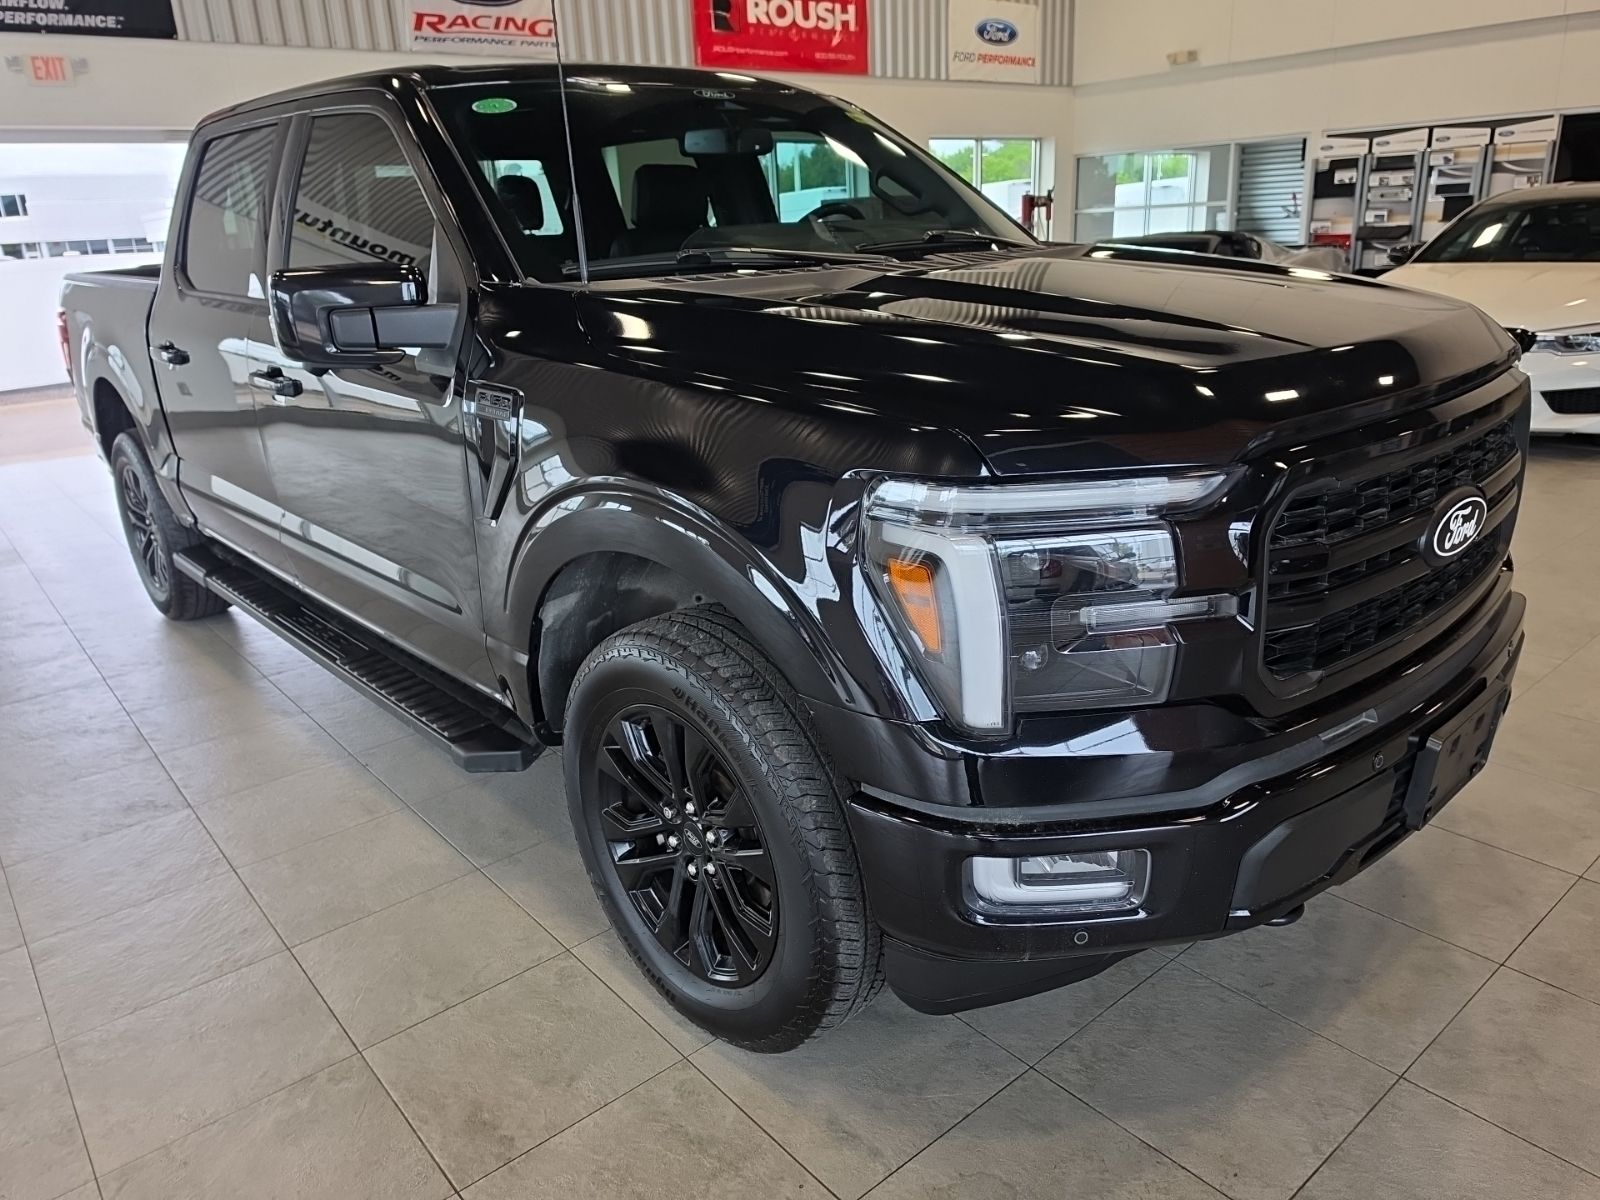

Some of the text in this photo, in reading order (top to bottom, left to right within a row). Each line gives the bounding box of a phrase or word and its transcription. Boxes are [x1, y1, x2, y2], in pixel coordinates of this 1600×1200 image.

[413, 11, 554, 38] RACING
[746, 0, 857, 32] ROUSH
[413, 35, 557, 49] PERFORMANCE PARTS
[30, 56, 66, 81] EXIT
[952, 51, 1037, 67] FORD PERFORMANCE
[1444, 505, 1479, 549] Ford
